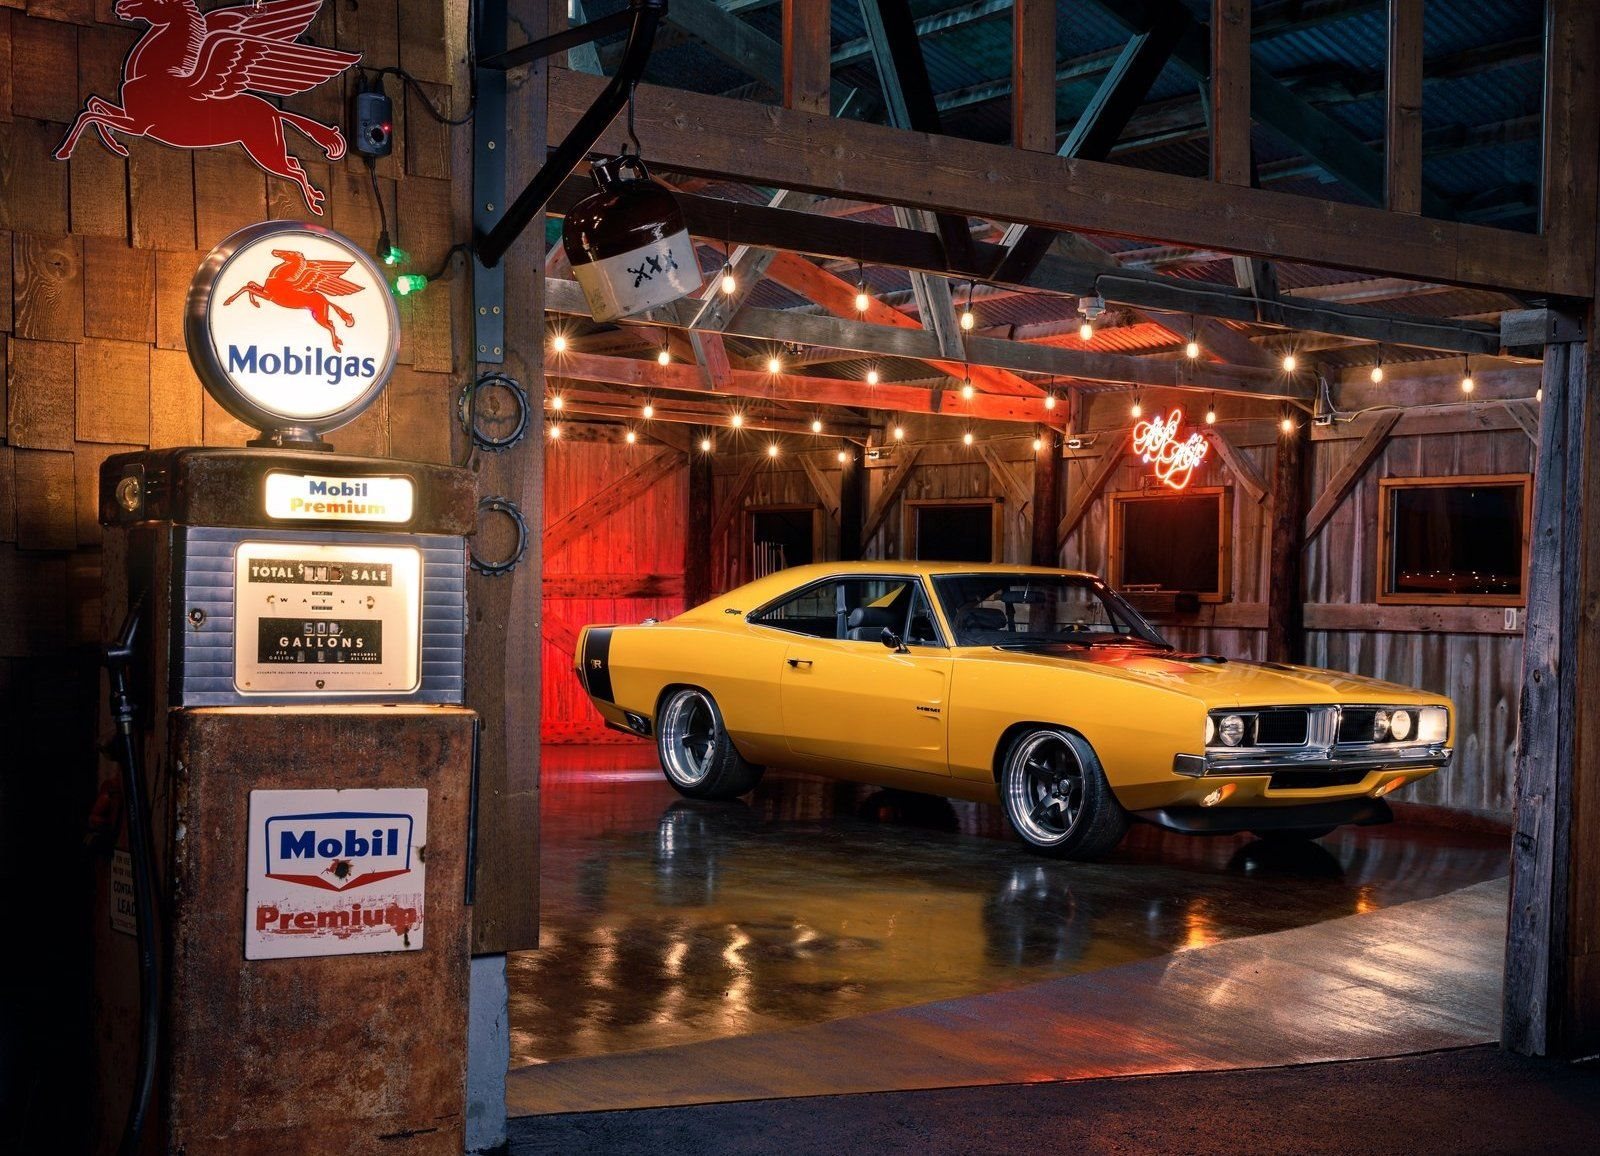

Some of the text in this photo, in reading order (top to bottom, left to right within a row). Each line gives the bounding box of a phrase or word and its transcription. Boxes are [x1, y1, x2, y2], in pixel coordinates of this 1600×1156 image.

[228, 344, 376, 385] Mobilgas
[309, 481, 368, 497] Mobil
[289, 497, 385, 514] Premium
[252, 566, 294, 578] TOTAL
[351, 569, 387, 581] SALE
[279, 637, 364, 648] GALLONS
[280, 828, 399, 859] Mobil
